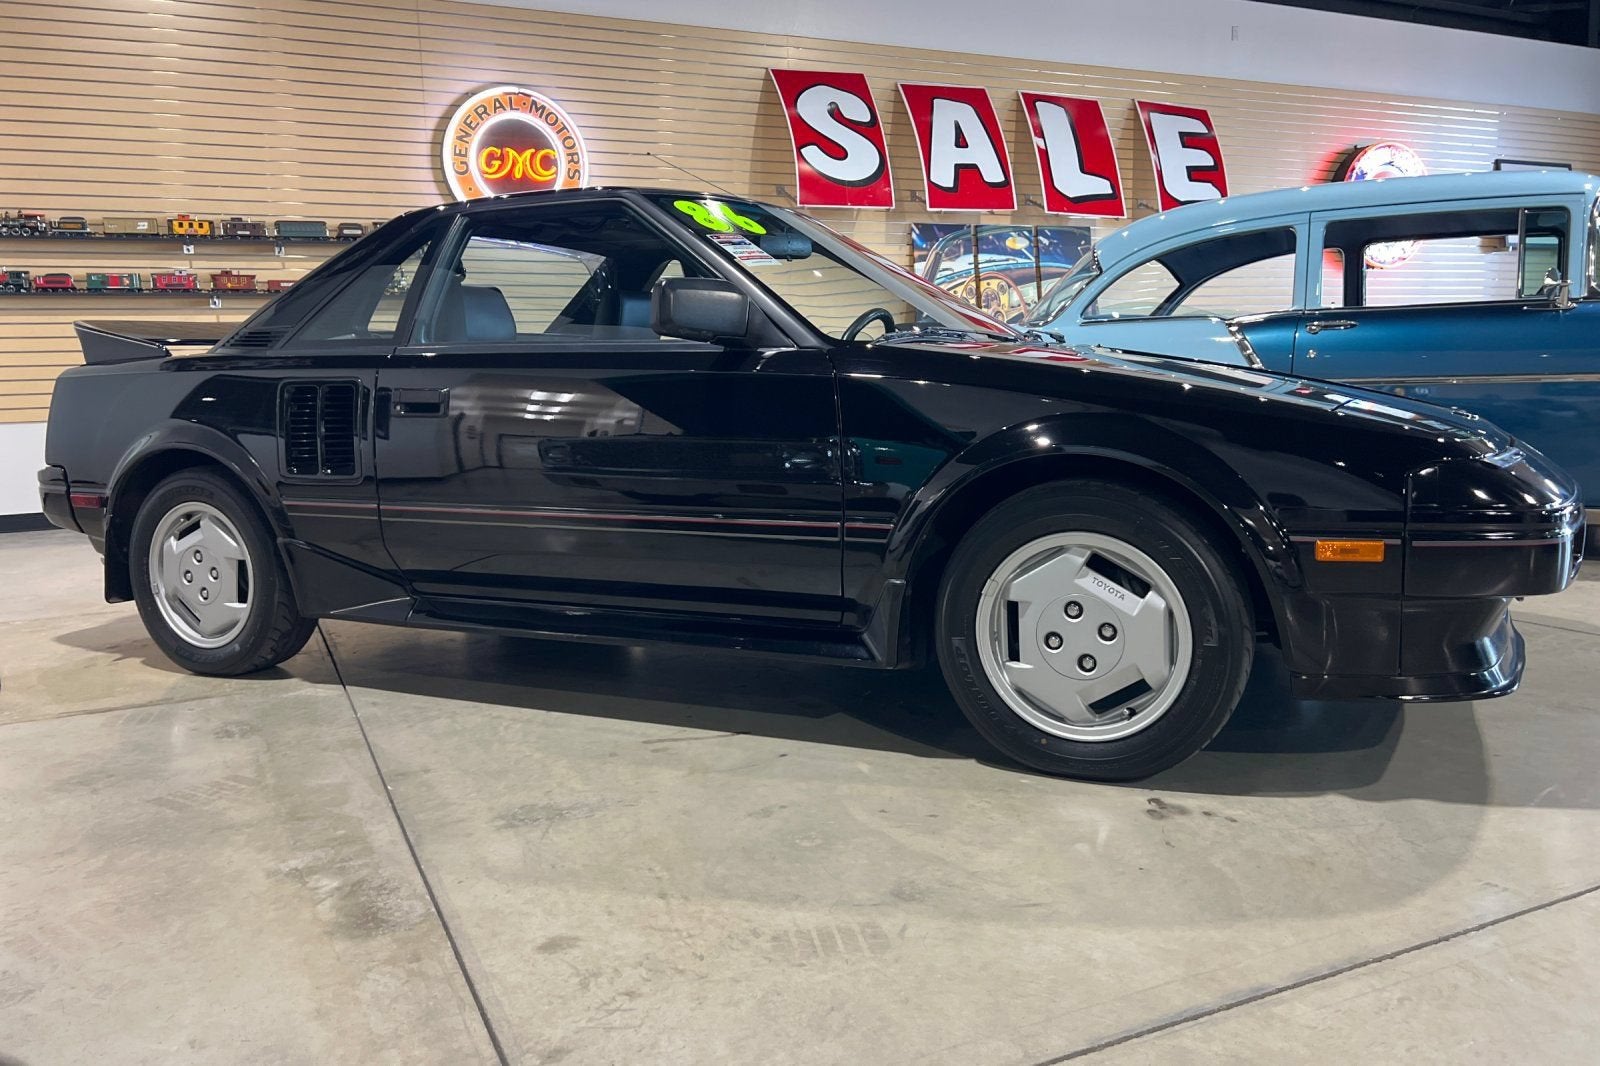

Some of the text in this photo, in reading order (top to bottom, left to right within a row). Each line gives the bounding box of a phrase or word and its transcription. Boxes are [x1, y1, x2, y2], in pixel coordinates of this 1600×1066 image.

[452, 95, 581, 182] GENERAL MOTORS
[794, 83, 1223, 202] SALE
[479, 146, 558, 182] GMC
[673, 199, 767, 235] 86
[1092, 576, 1126, 601] TOYOTA
